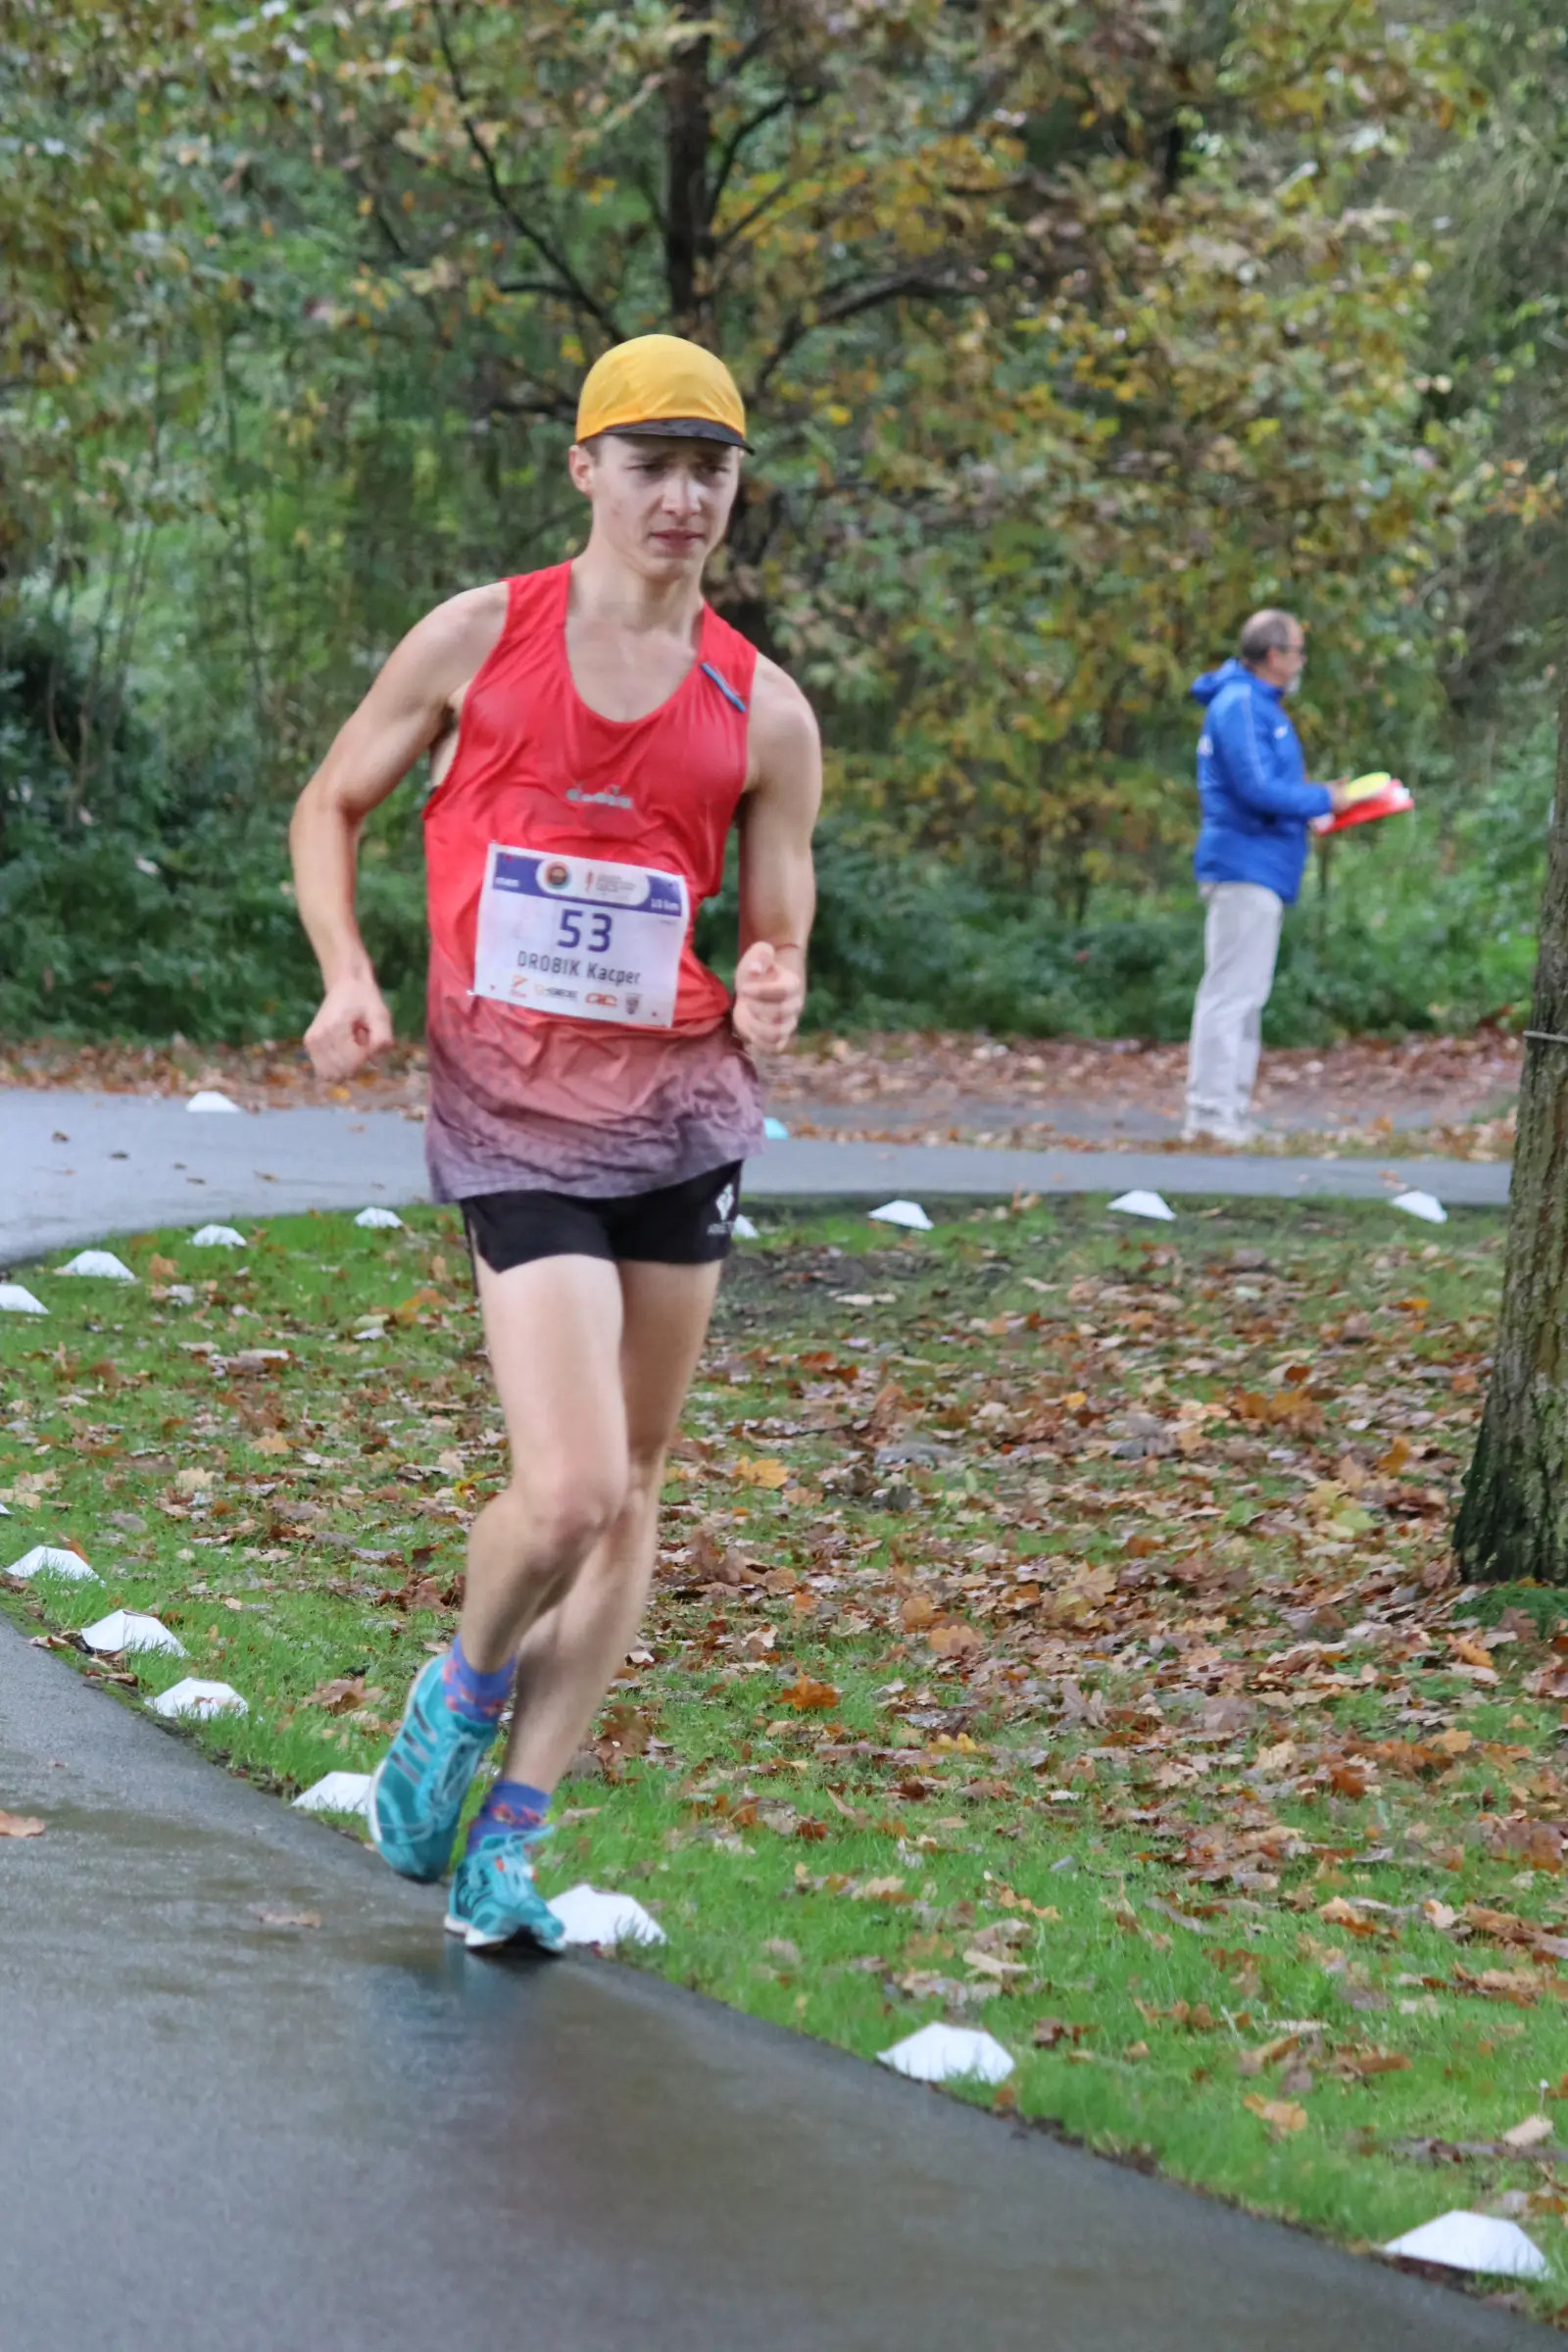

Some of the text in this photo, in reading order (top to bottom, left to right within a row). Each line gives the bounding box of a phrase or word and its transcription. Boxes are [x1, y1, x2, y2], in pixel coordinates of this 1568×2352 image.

[557, 907, 613, 954] 53
[517, 950, 641, 987] DROBIK Kacper
